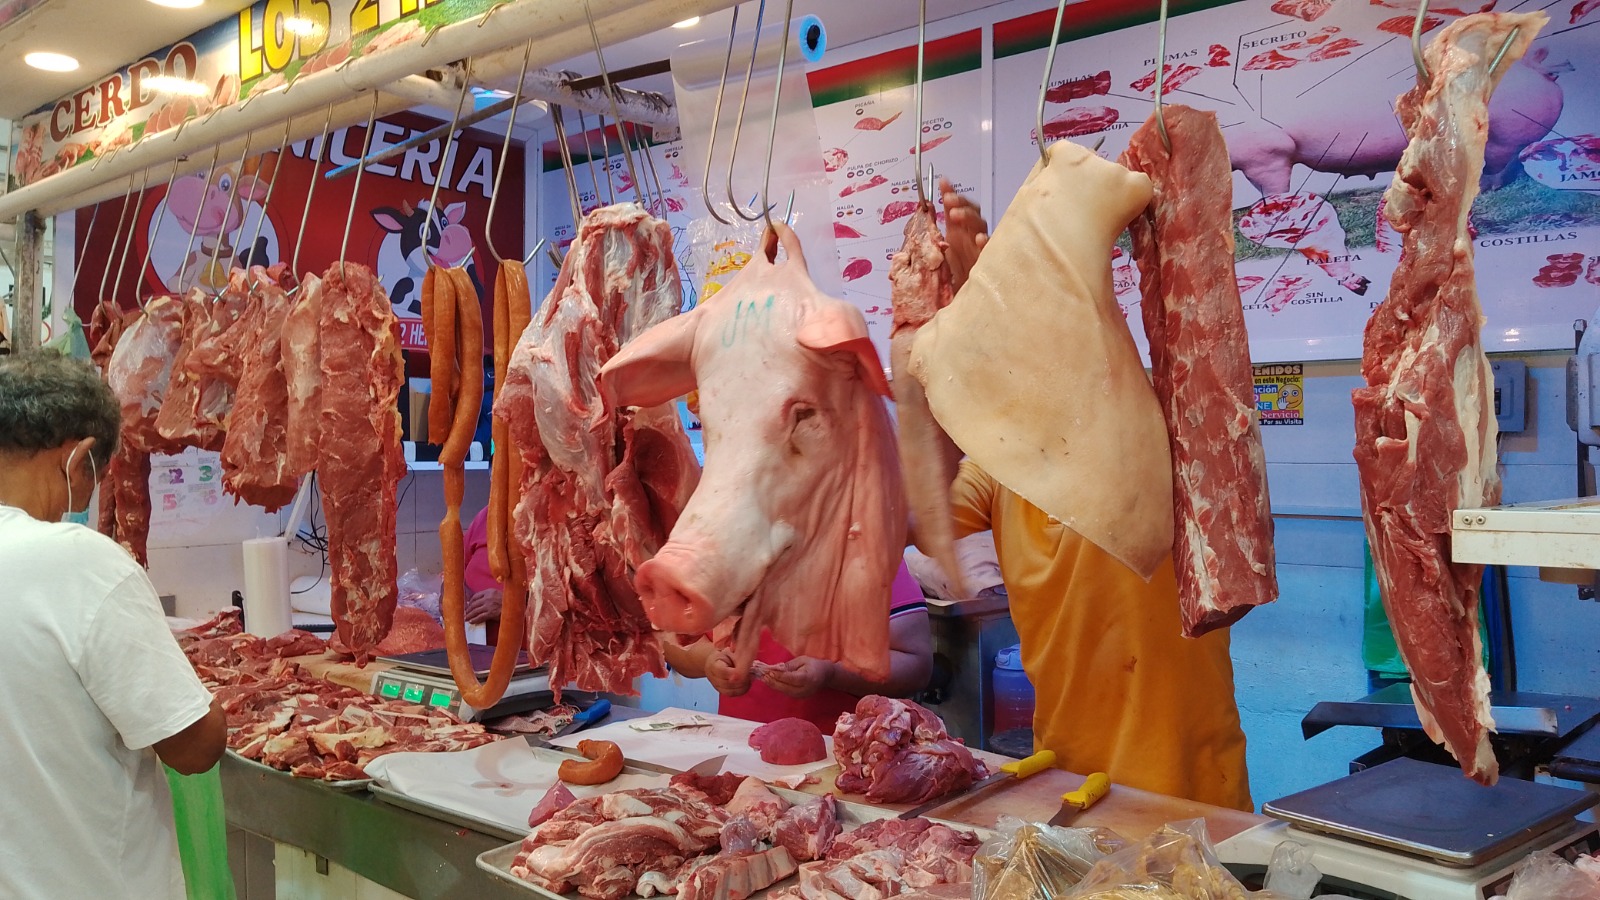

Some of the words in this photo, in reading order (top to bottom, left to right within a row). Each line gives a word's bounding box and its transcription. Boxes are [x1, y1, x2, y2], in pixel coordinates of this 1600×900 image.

[1242, 30, 1307, 50] SECRETO
[50, 42, 198, 143] CERDO
[1097, 122, 1129, 133] AGUJA
[874, 157, 898, 166] CHORIZO
[891, 179, 910, 187] NALGA
[836, 204, 855, 212] NALGA
[1480, 231, 1578, 248] COSTILLAS
[1306, 254, 1362, 266] PALETA
[1305, 291, 1324, 299] SIN
[1291, 296, 1343, 306] COSTILLA
[1242, 303, 1270, 311] CETA
[1253, 366, 1301, 375] ENIDOS
[1262, 410, 1299, 419] Servicio
[199, 465, 213, 481] 3
[163, 493, 177, 510] 5
